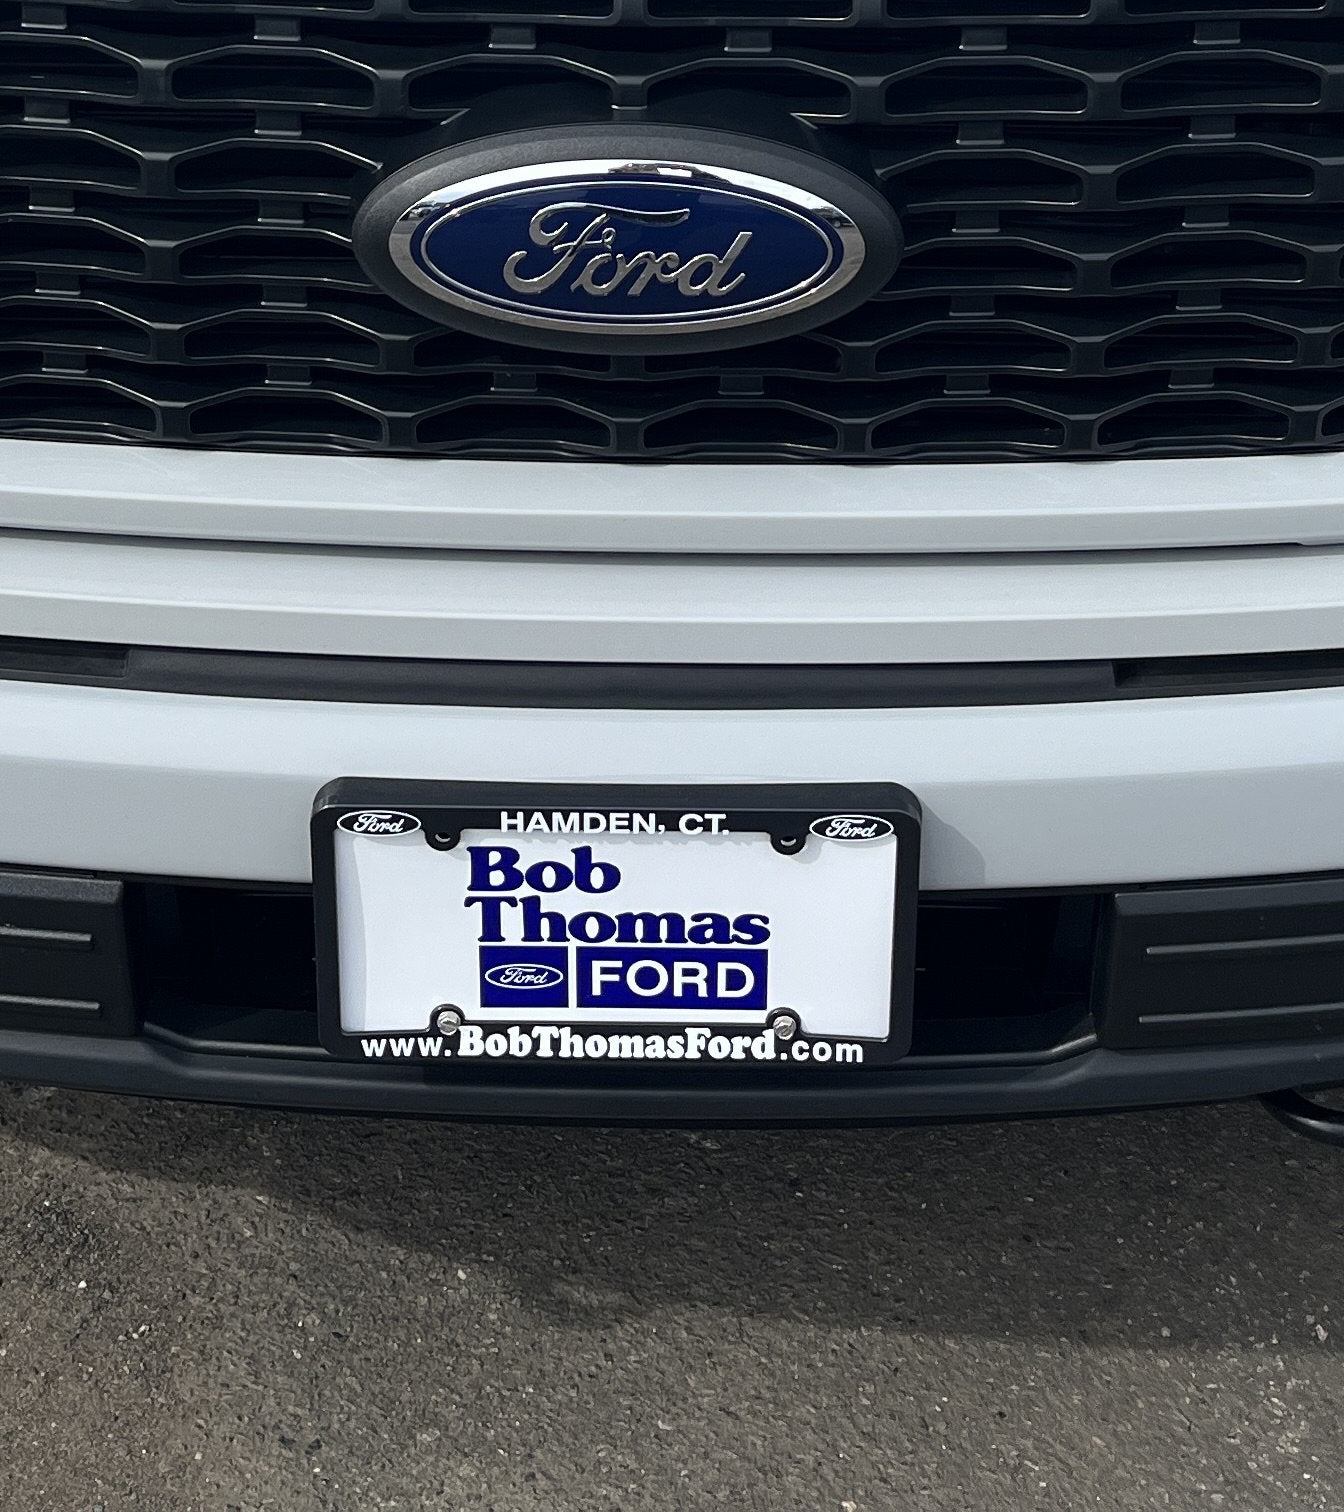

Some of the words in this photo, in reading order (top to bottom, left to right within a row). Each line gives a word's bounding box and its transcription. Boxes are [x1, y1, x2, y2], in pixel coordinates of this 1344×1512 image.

[503, 202, 753, 298] Ford
[353, 813, 405, 833] Ford
[501, 811, 666, 836] HAMDEN,
[678, 812, 730, 835] CT.
[825, 818, 878, 837] Ford
[466, 845, 622, 894] Bob
[464, 895, 771, 945] Thomas
[499, 967, 549, 984] Ford
[591, 959, 755, 998] FORD
[361, 1024, 865, 1064] www.BobThomasFord.com
